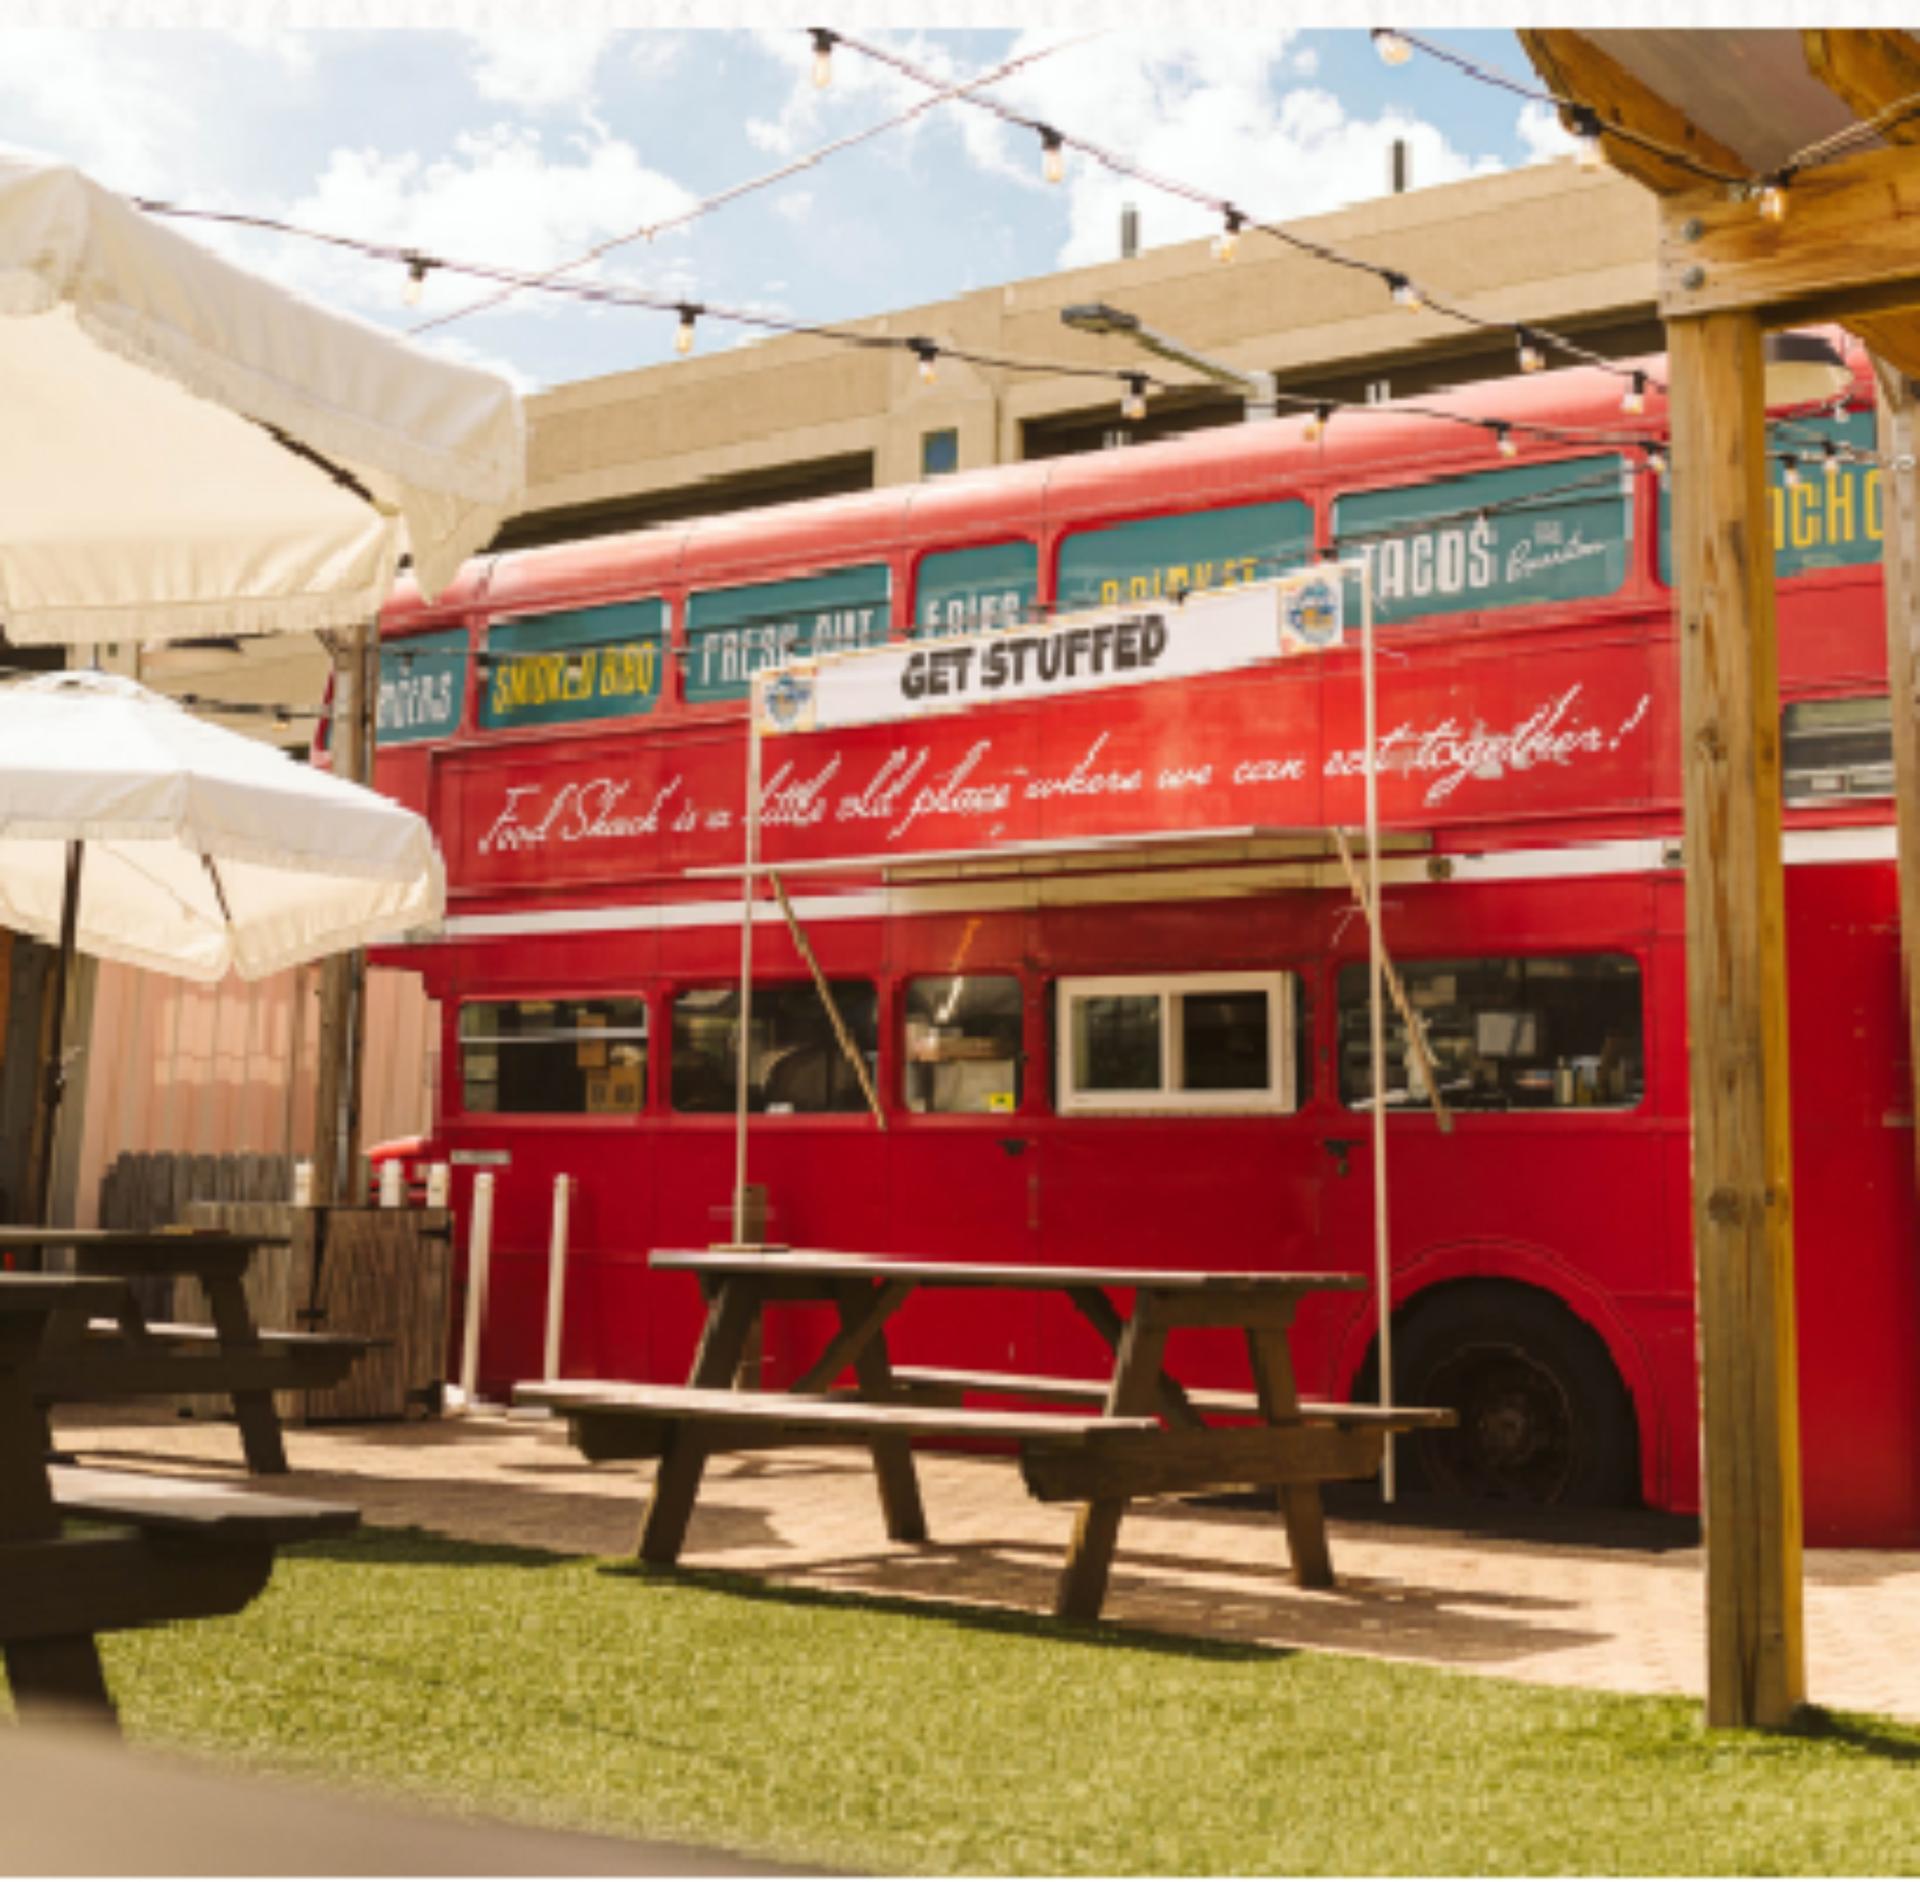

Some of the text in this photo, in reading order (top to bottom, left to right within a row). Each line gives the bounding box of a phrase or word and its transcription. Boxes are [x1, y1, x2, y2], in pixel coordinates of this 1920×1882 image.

[900, 614, 1167, 699] GET STUFFED
[478, 783, 578, 854] Food
[560, 774, 682, 841] Shack
[671, 797, 697, 832] is
[704, 809, 731, 829] a
[742, 751, 841, 827] little
[835, 746, 930, 822] old
[887, 738, 1009, 840] place
[1023, 731, 1143, 798] where
[1156, 763, 1214, 791] we
[1232, 759, 1305, 785] can
